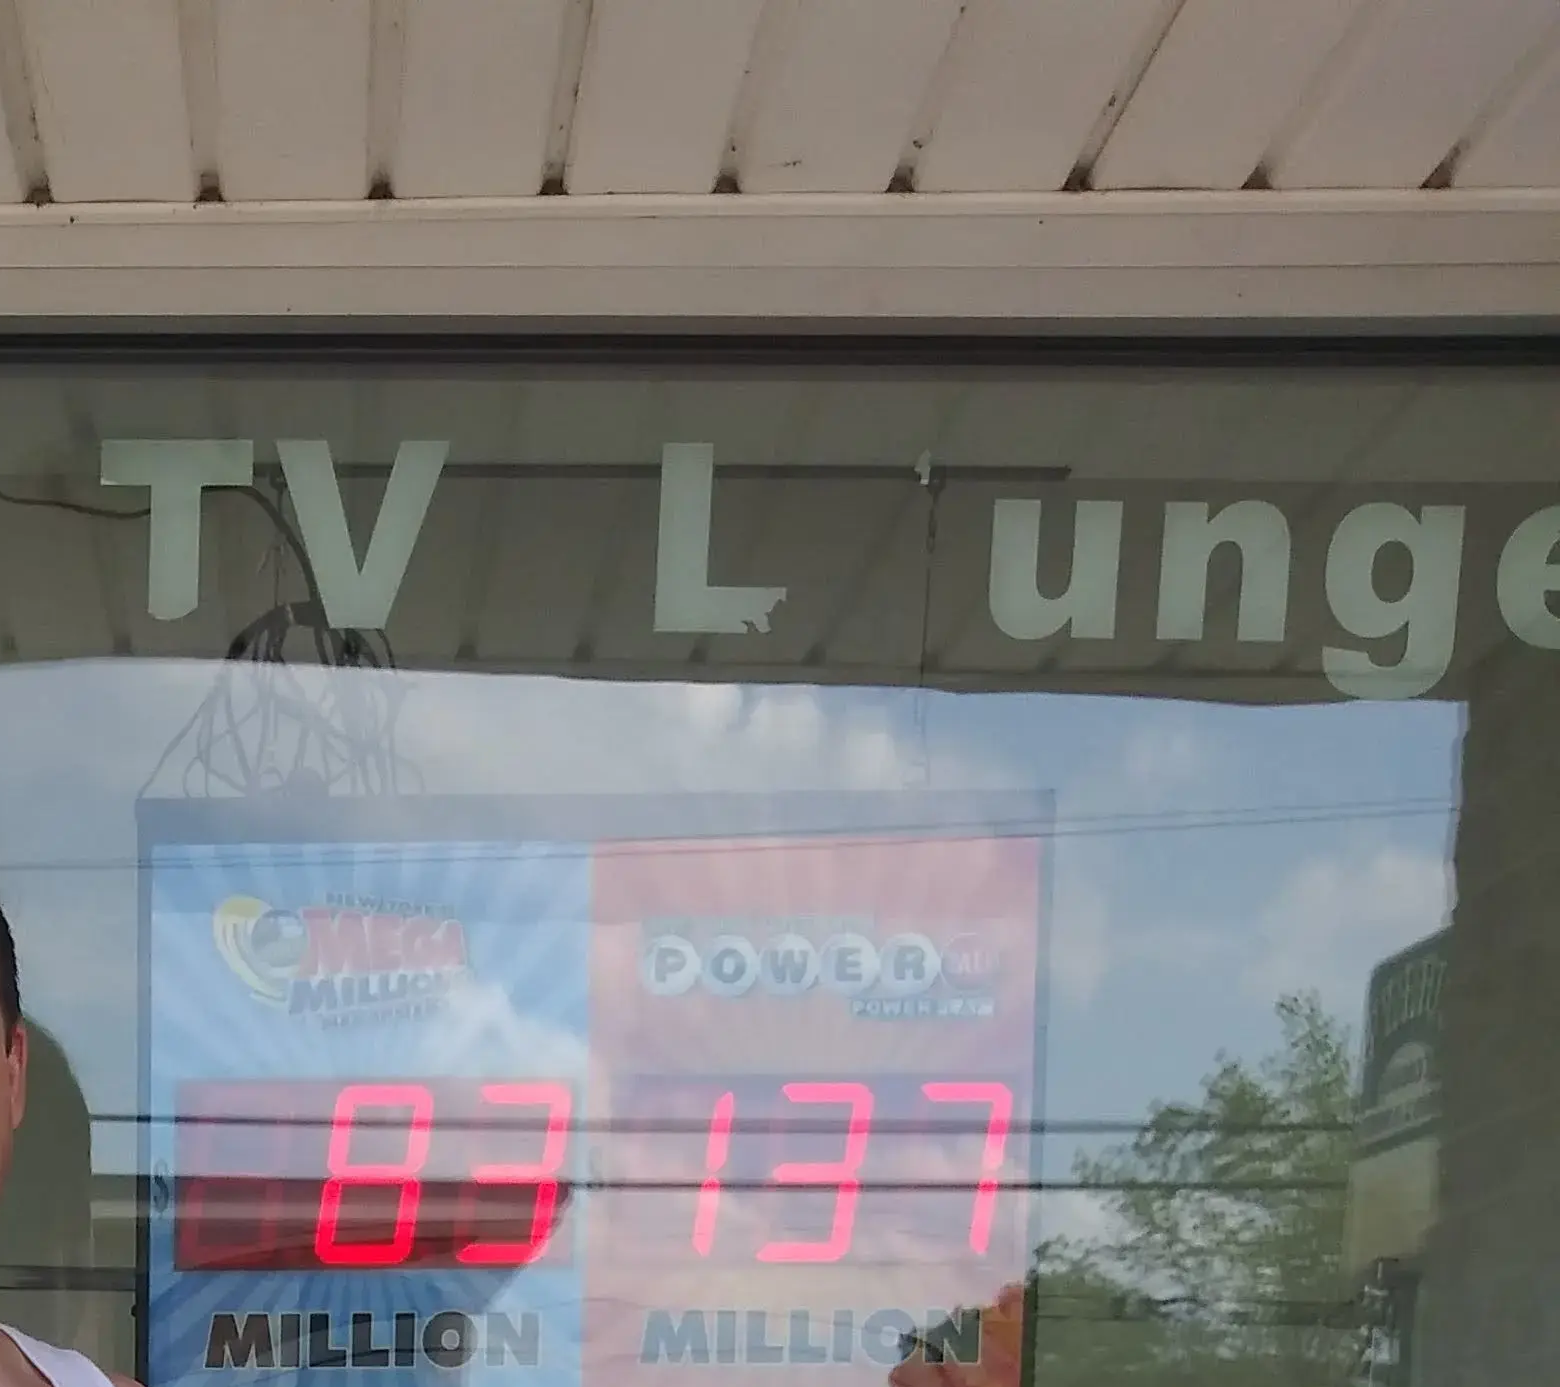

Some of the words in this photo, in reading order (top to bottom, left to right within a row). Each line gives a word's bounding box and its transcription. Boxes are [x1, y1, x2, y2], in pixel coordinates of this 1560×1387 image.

[100, 439, 450, 630] TV
[296, 906, 468, 980] MEGA
[313, 1084, 571, 1264] 83
[692, 1082, 1014, 1262] 137
[203, 1311, 542, 1371] MILLION
[640, 1307, 982, 1366] MILLION
